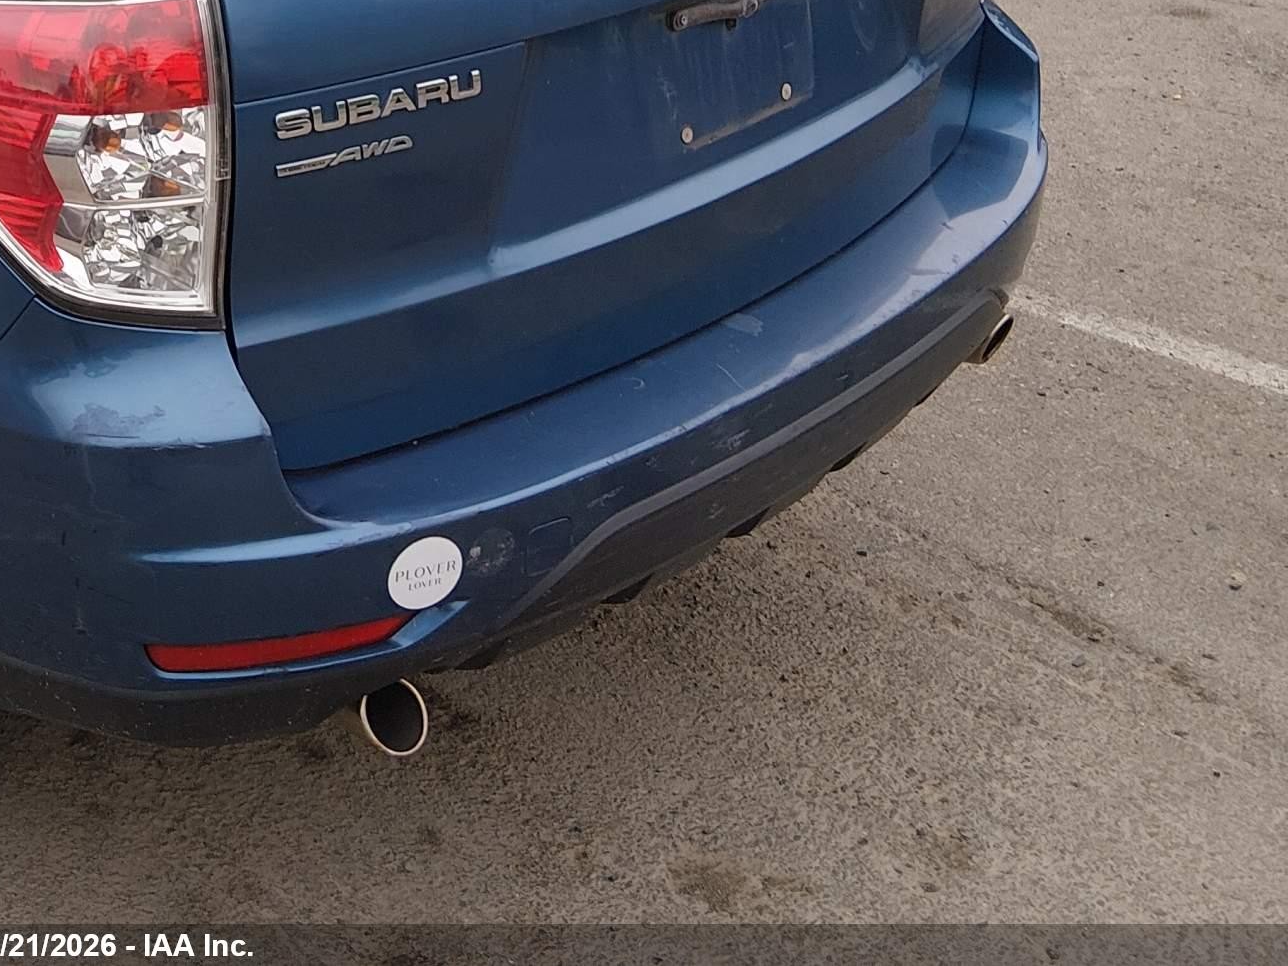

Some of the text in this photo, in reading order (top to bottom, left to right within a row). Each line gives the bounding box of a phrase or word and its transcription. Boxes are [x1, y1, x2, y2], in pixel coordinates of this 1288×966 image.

[275, 69, 482, 140] SUBARU
[329, 135, 413, 166] AWD
[394, 559, 457, 583] PLOVER
[408, 577, 442, 591] LOVER
